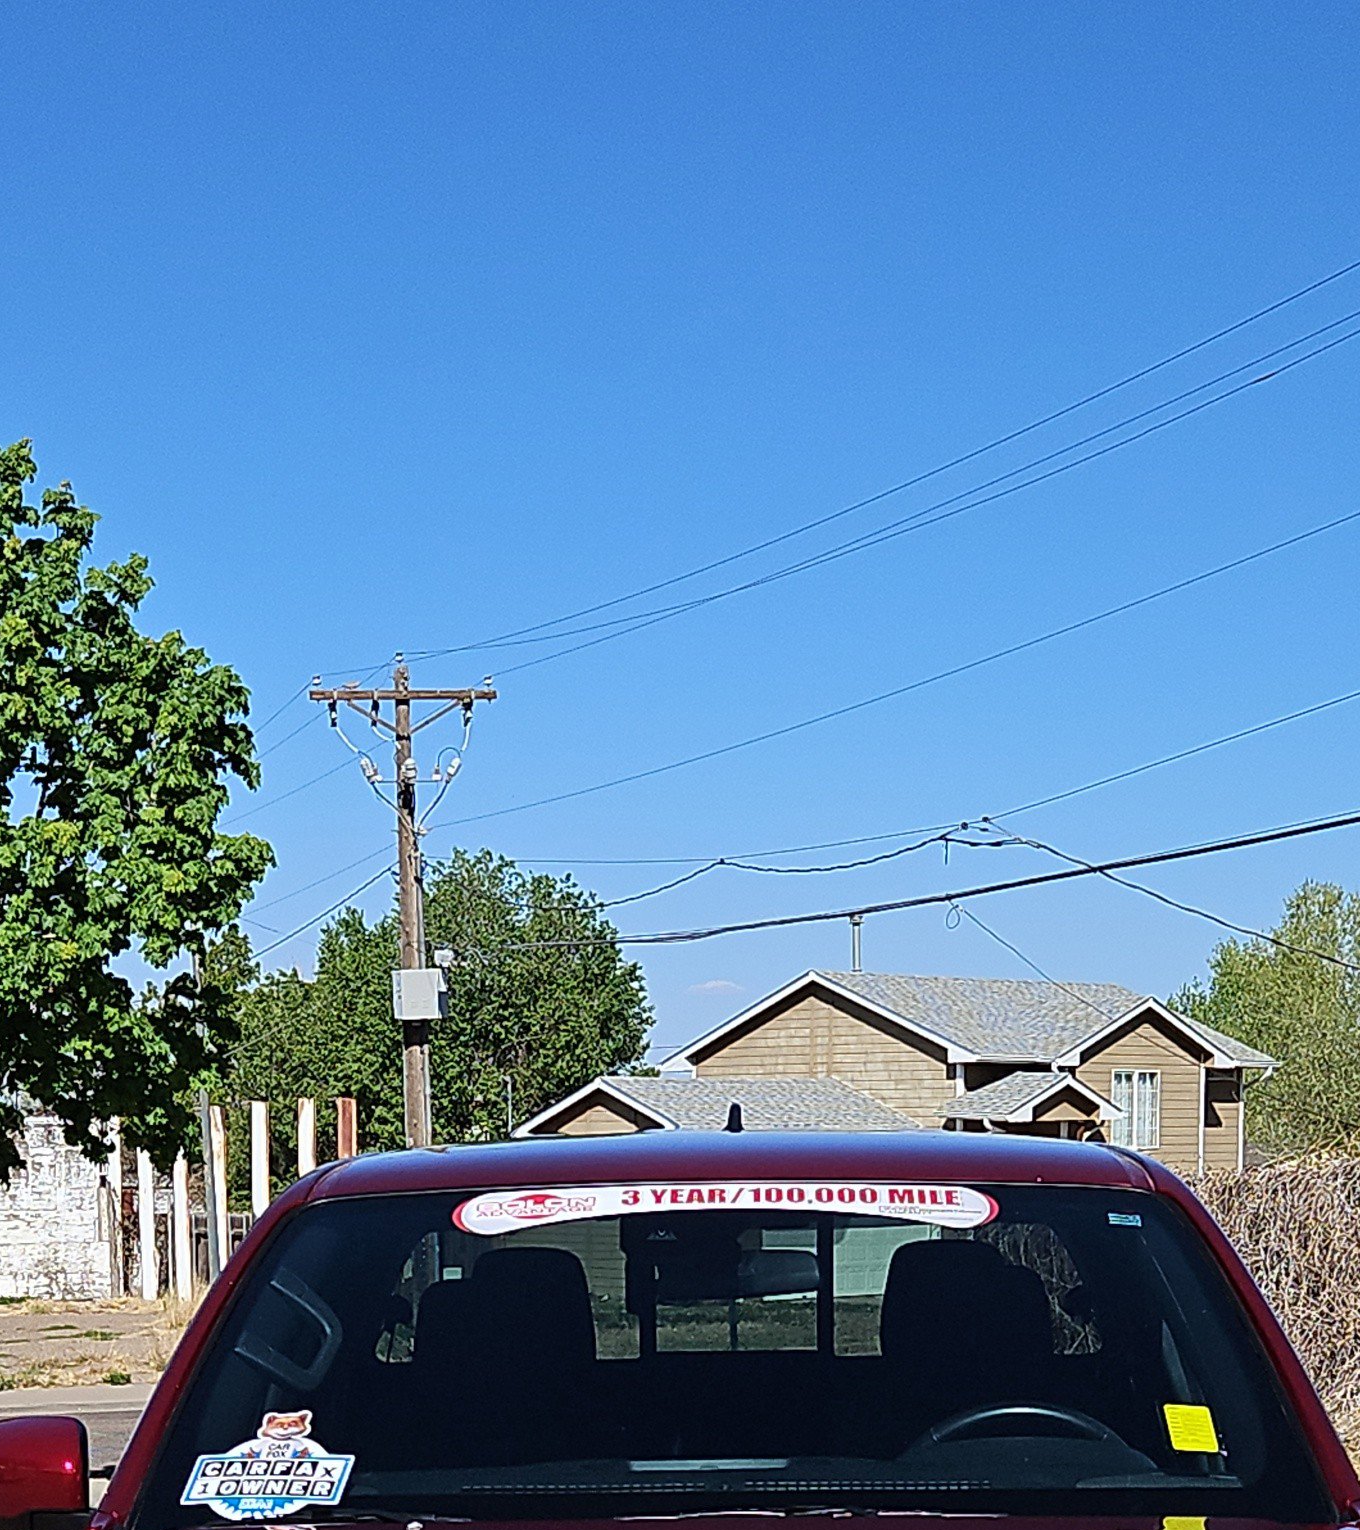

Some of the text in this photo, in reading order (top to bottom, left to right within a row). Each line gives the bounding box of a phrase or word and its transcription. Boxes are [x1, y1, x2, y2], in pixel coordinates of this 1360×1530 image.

[621, 1189, 641, 1206] 3
[887, 1188, 961, 1207] MILE
[476, 1206, 594, 1218] ADVANTAGE
[266, 1450, 288, 1458] FOX
[268, 1443, 291, 1451] CAR
[201, 1460, 337, 1479] CARFAX
[198, 1480, 335, 1497] 1 OWNER
